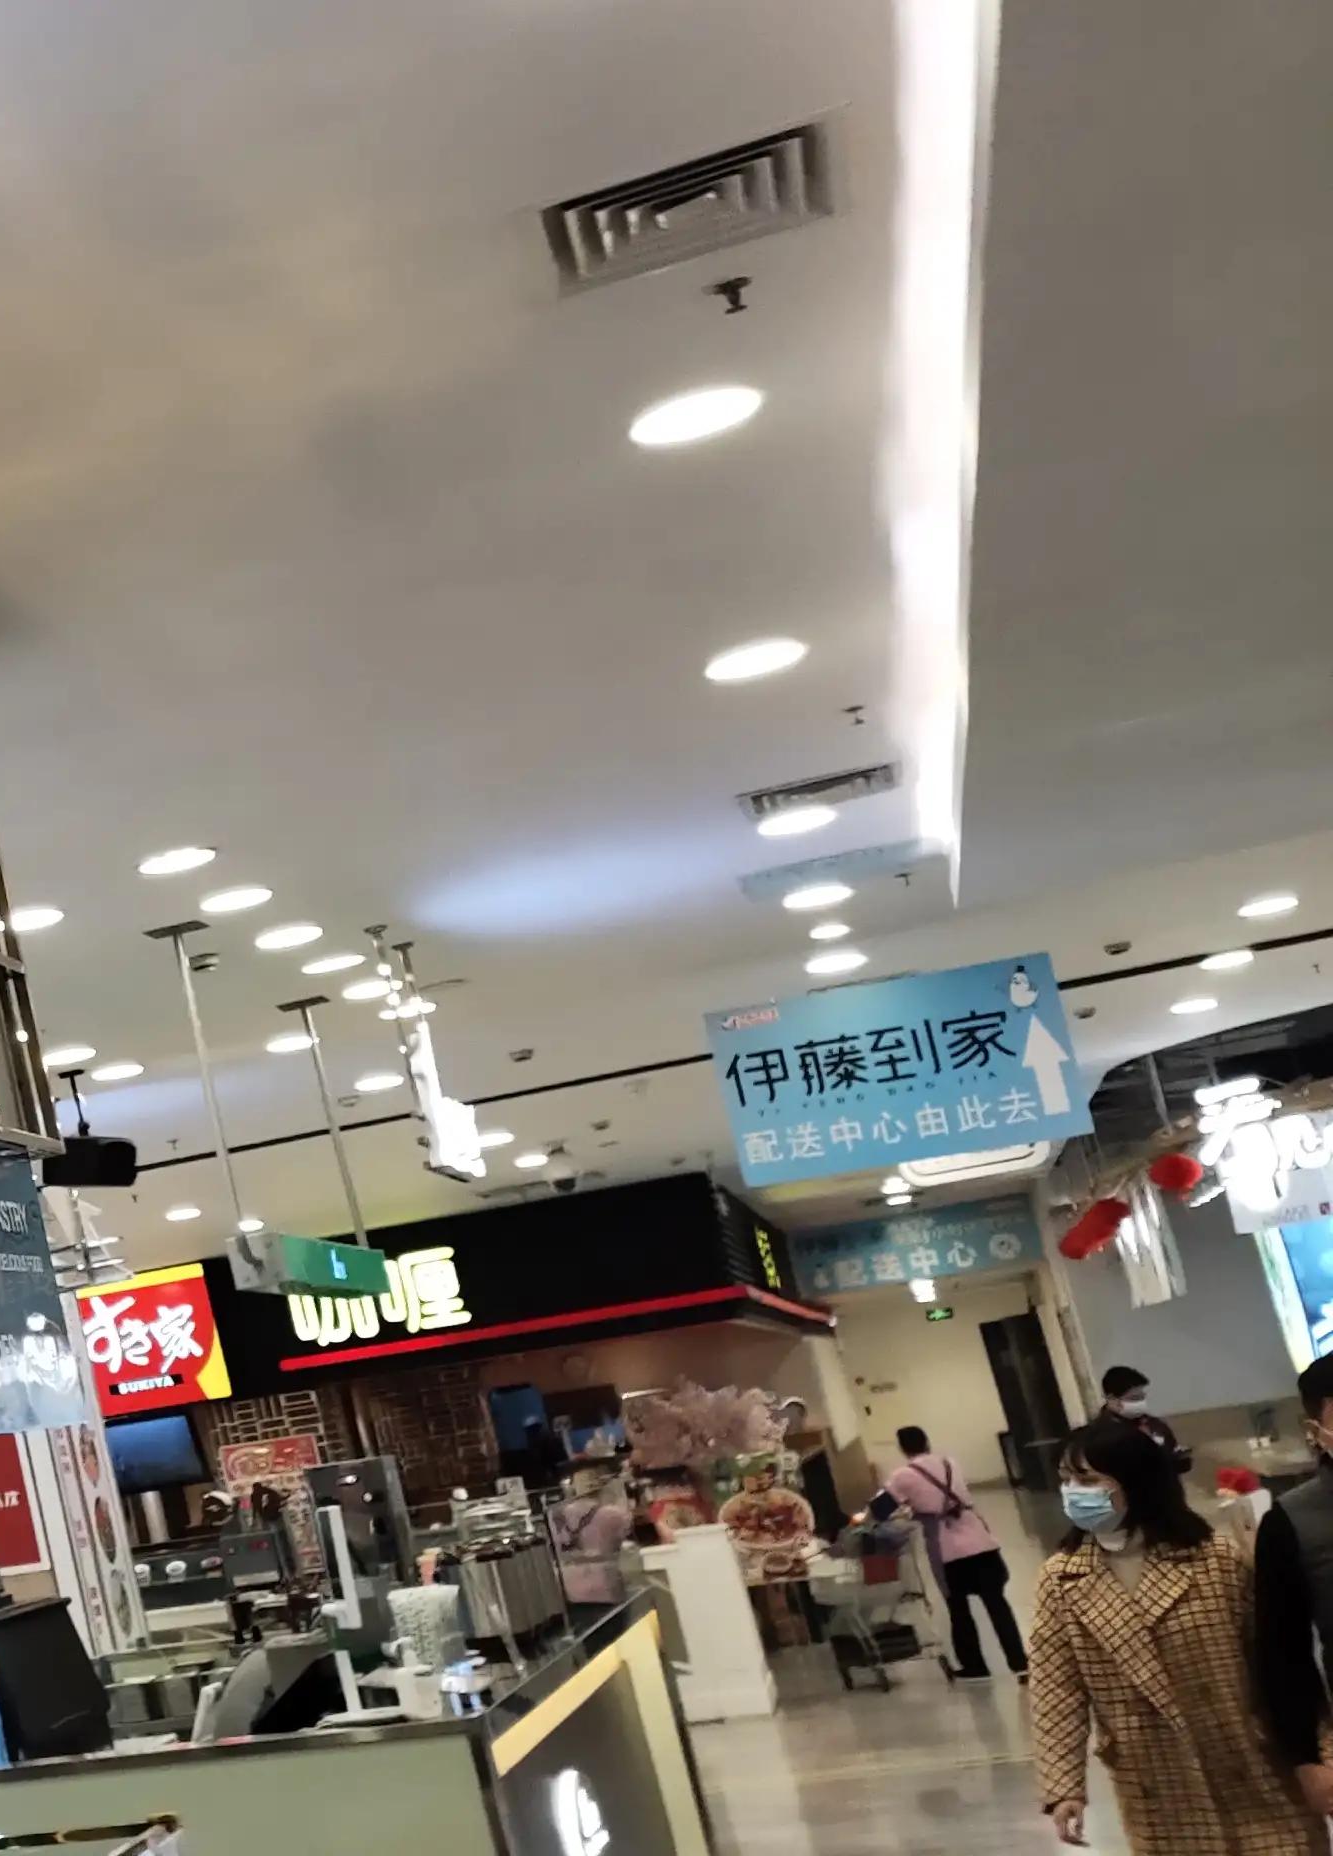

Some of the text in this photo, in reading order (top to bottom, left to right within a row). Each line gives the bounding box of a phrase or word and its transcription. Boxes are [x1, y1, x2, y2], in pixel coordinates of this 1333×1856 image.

[726, 1010, 1018, 1107] 伊藤到家
[742, 1087, 1038, 1166] 配送中心由此去
[82, 1294, 204, 1375] すき家
